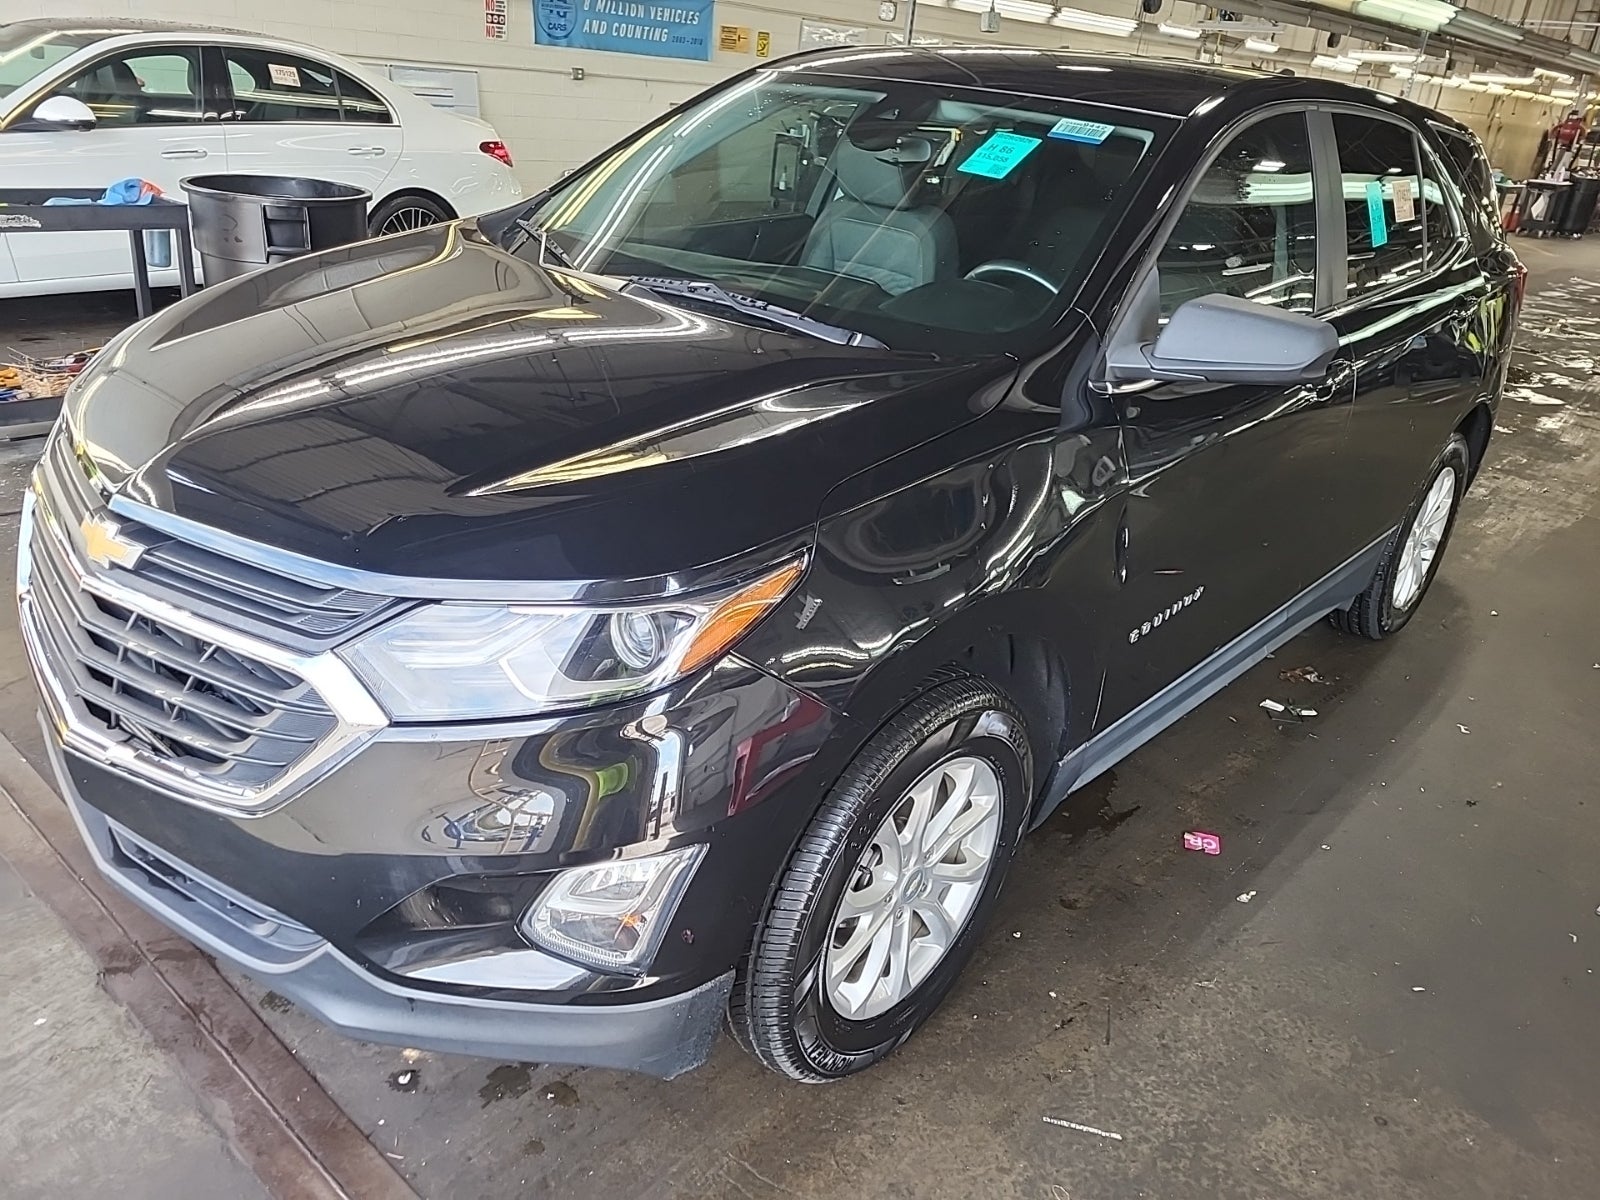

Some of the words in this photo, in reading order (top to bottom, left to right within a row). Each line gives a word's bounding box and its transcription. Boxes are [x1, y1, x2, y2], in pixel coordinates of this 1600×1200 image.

[485, 0, 495, 11] NO
[595, 0, 645, 18] MILLION
[650, 6, 700, 25] VEHICLES
[486, 25, 495, 38] NO
[548, 22, 567, 31] CARS
[583, 19, 607, 35] AND
[612, 22, 669, 42] COUNTING
